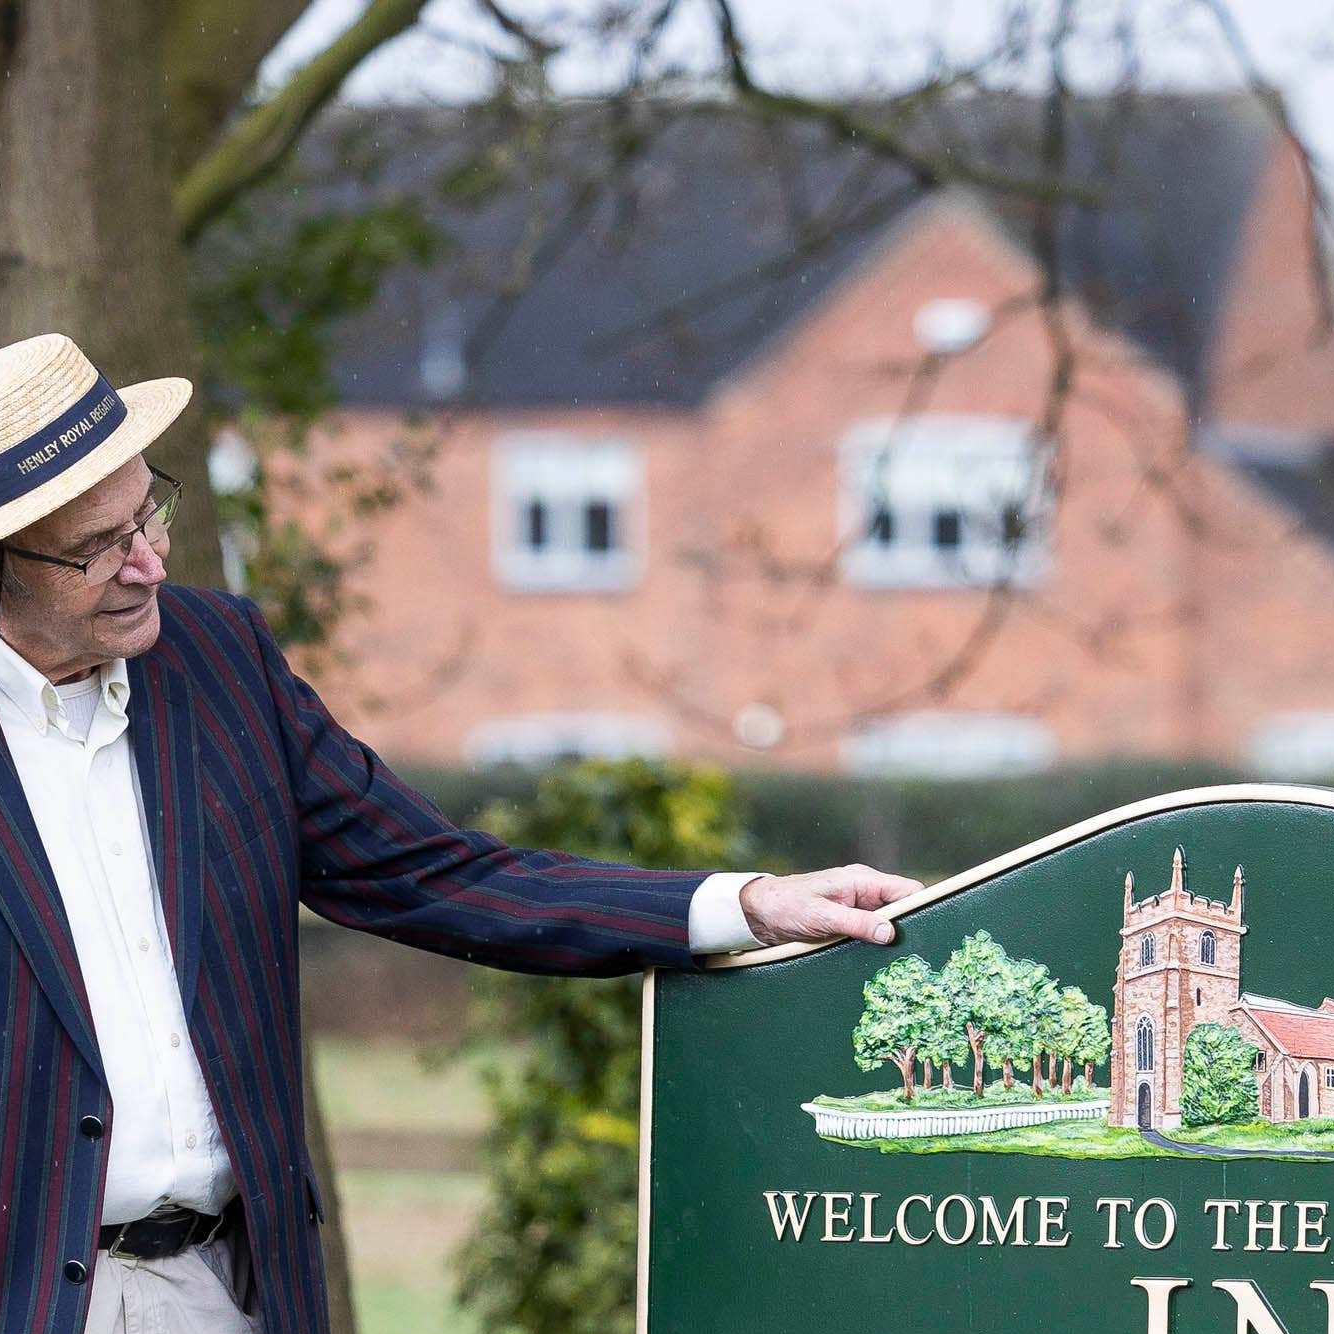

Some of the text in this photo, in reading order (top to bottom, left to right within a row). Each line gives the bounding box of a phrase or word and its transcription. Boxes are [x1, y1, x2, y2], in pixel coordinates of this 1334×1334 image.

[17, 440, 60, 475] HENLEY
[59, 418, 93, 448] ROYAL
[763, 1190, 1072, 1247] WELCOME
[1096, 1197, 1177, 1250] TO
[1204, 1198, 1332, 1253] THE
